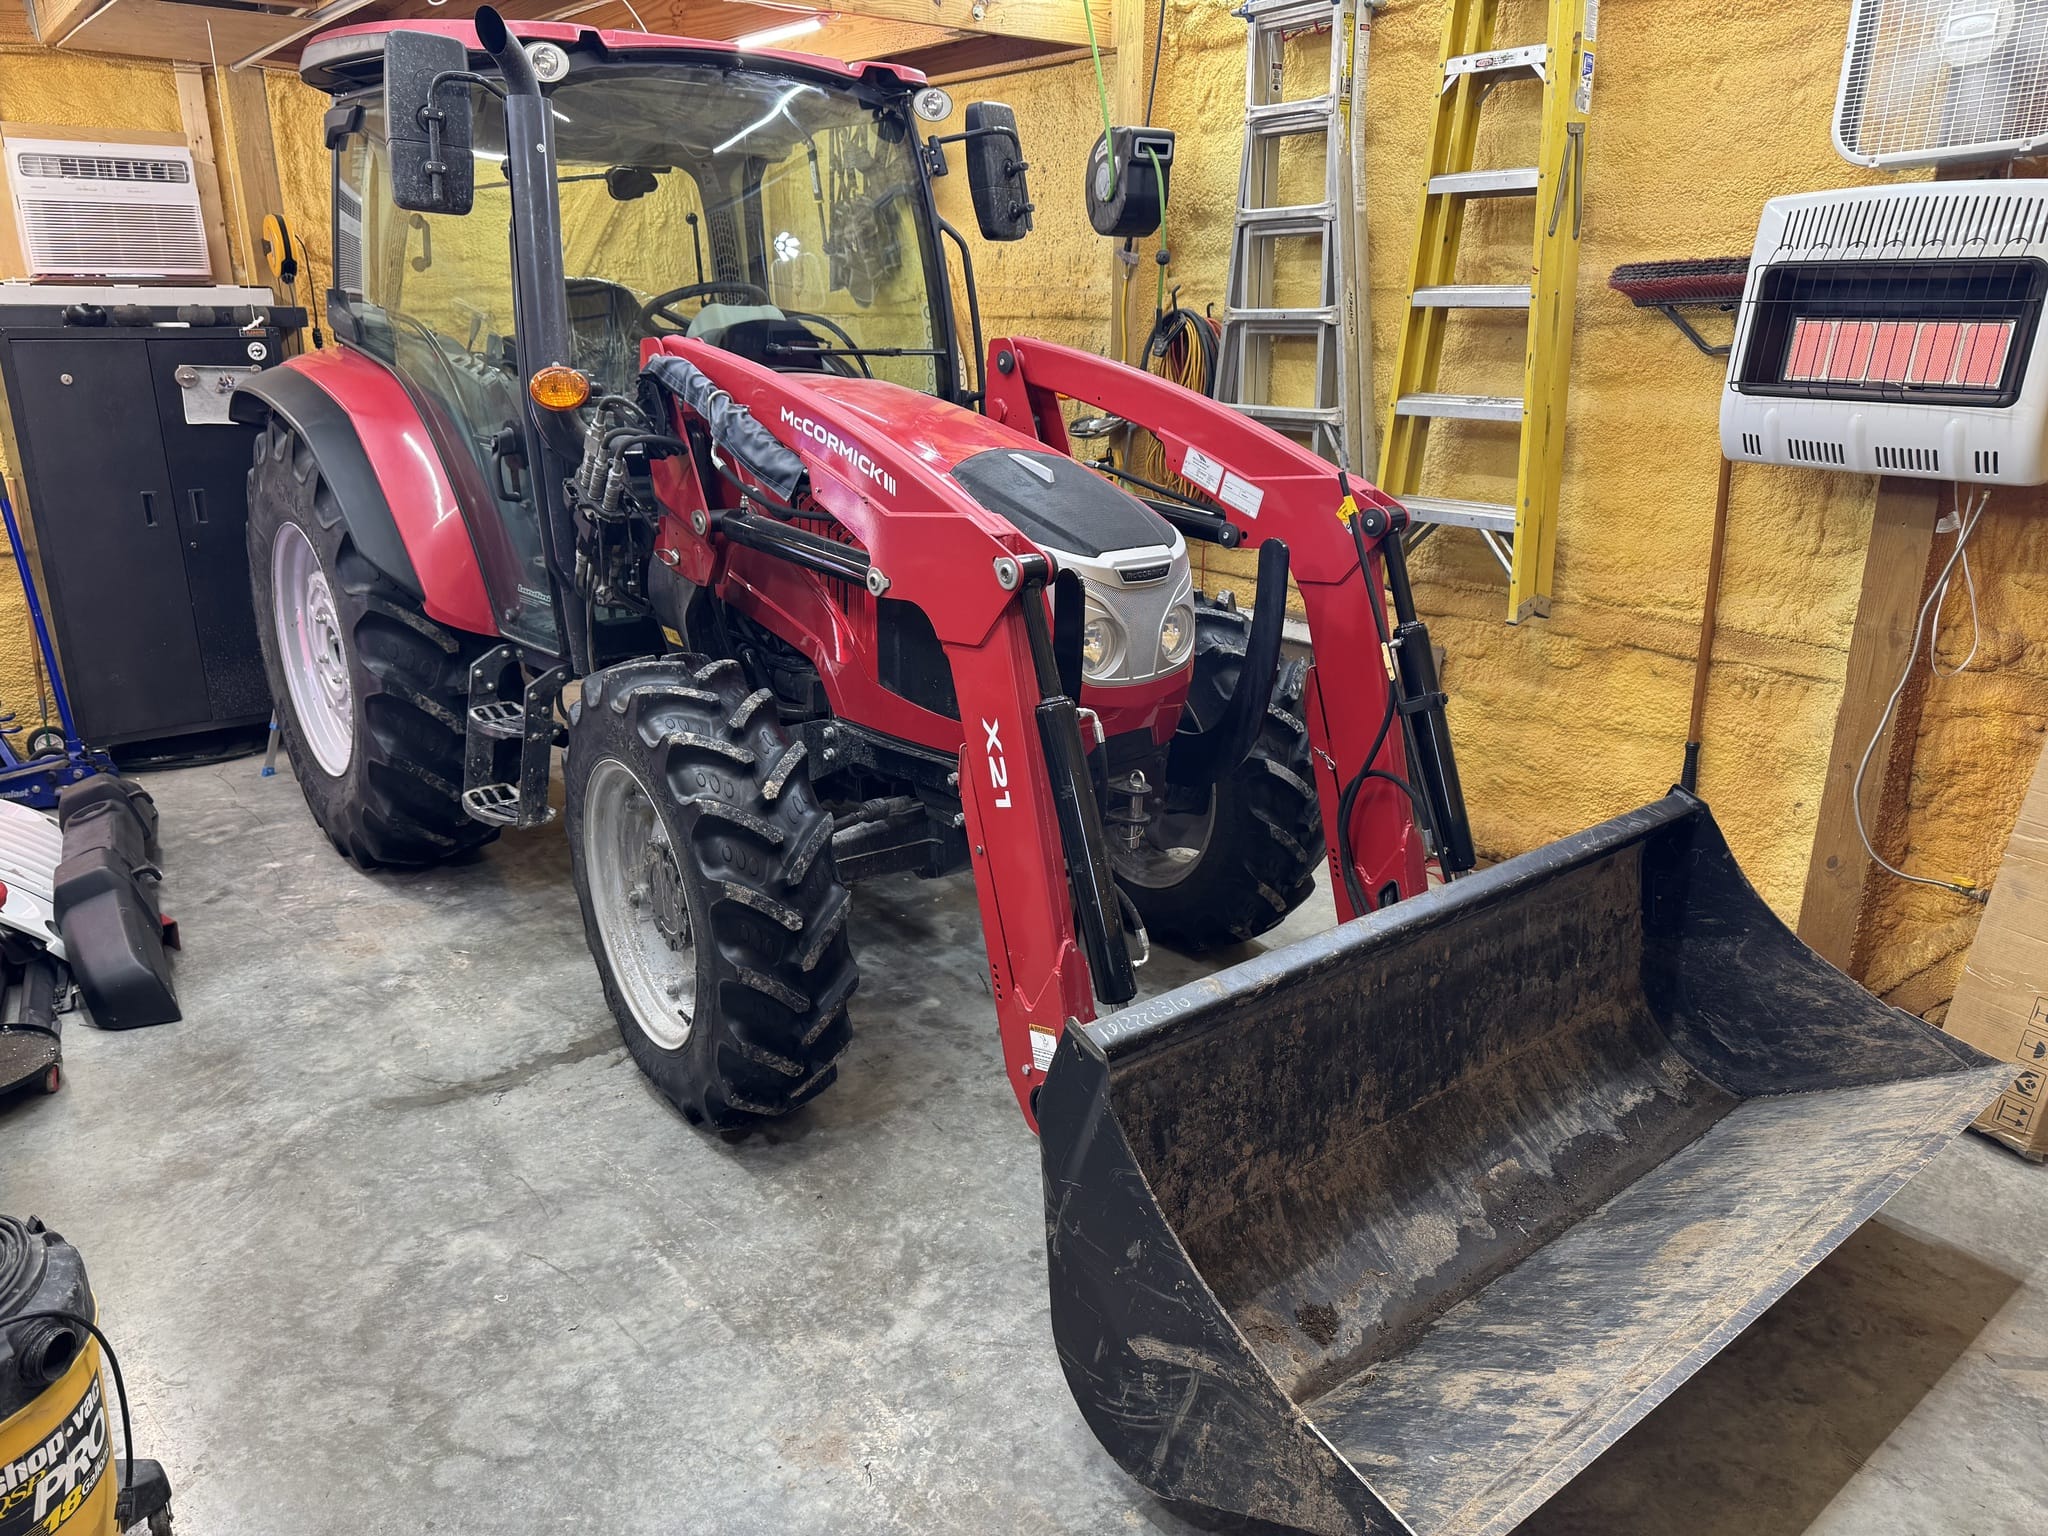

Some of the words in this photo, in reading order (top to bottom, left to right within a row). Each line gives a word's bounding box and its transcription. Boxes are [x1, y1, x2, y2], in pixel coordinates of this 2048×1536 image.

[982, 717, 1012, 808] X21
[33, 1406, 106, 1523] PRO
[43, 1484, 82, 1534] 18
